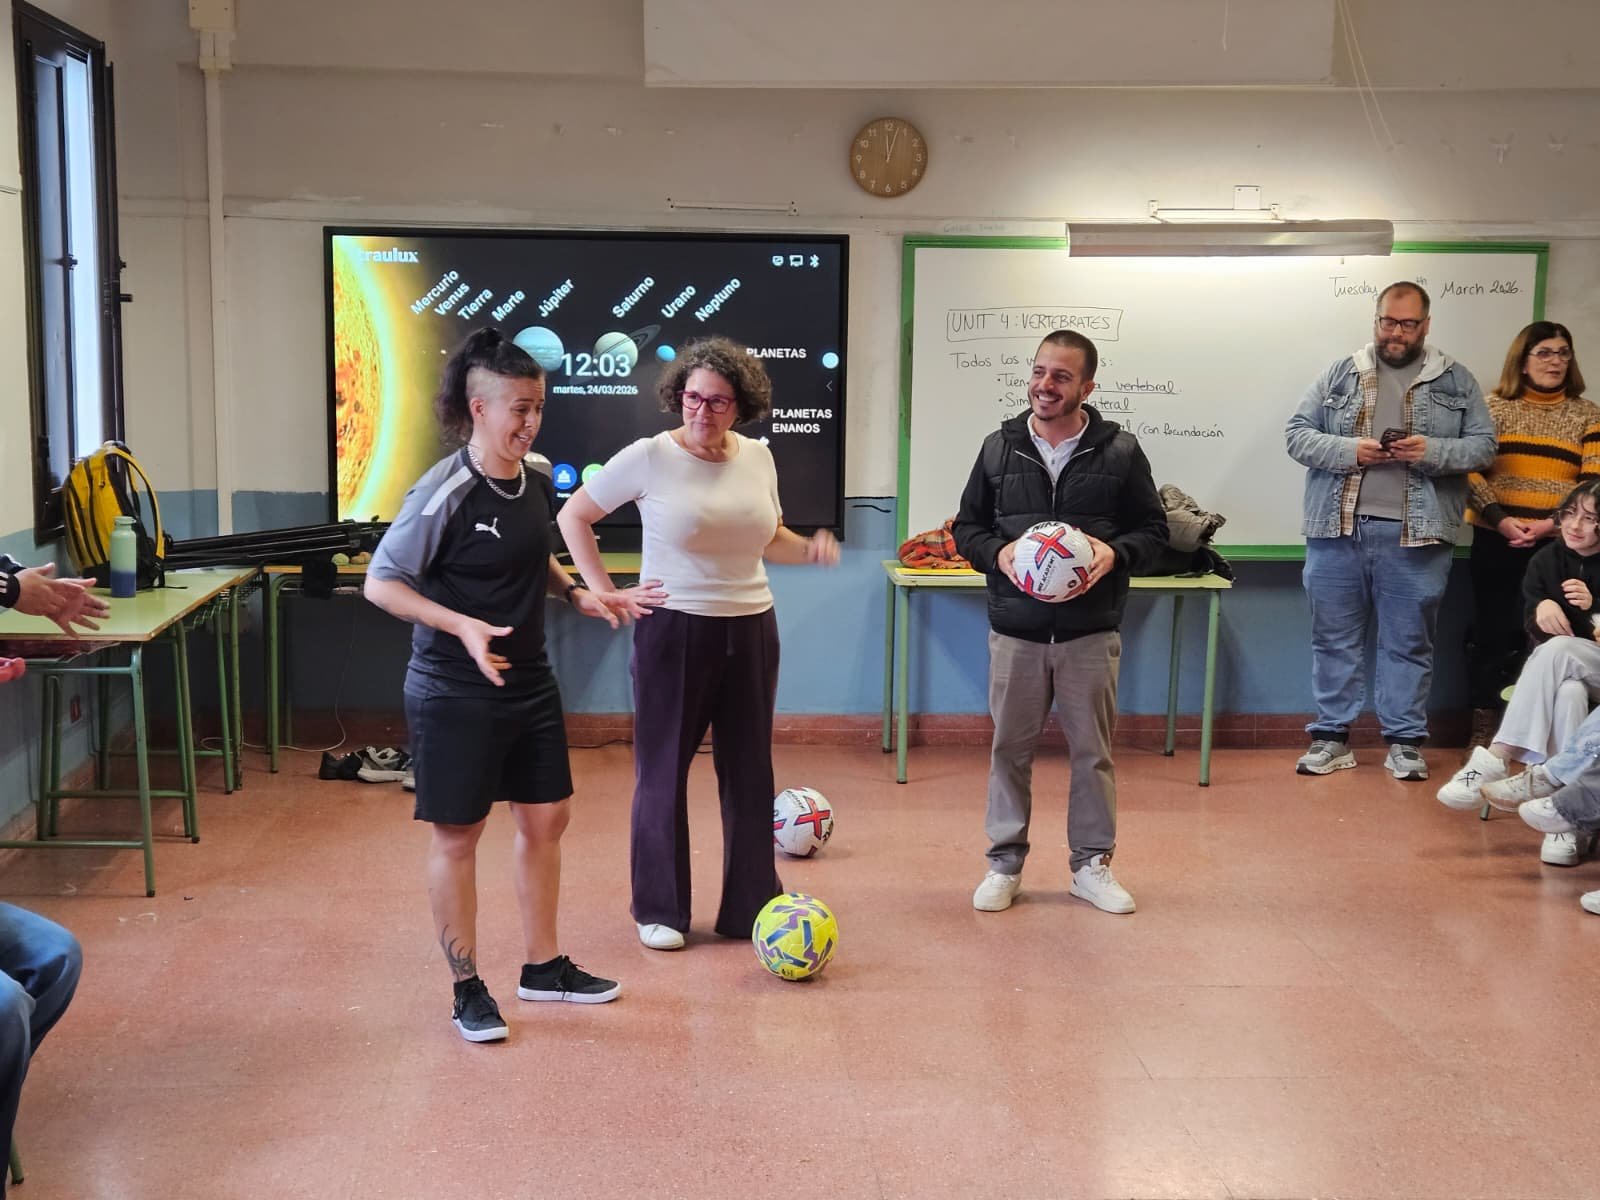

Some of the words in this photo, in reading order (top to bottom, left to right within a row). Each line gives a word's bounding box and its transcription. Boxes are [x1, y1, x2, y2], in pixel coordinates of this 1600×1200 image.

[855, 154, 863, 165] 9
[884, 183, 892, 193] 6
[410, 270, 459, 315] Mercurio
[612, 276, 655, 318] Saturno
[1328, 276, 1378, 302] Tuesday
[1440, 280, 1484, 299] March
[434, 283, 470, 316] Venus
[457, 289, 493, 320] Tierra
[491, 290, 525, 322] Marte
[661, 285, 696, 318] Urano
[694, 278, 741, 322] Neptuno
[952, 313, 996, 333] UNIT
[1022, 313, 1111, 330] VERTEBRATES
[746, 347, 807, 359] PLANETAS
[949, 352, 992, 369] Todos
[560, 352, 632, 377] 12:03
[997, 372, 1029, 388] Tien
[552, 385, 586, 396] martes,
[586, 385, 639, 396] 24/03/2026
[772, 408, 833, 419] PLANETAS
[772, 423, 821, 434] ENANOS
